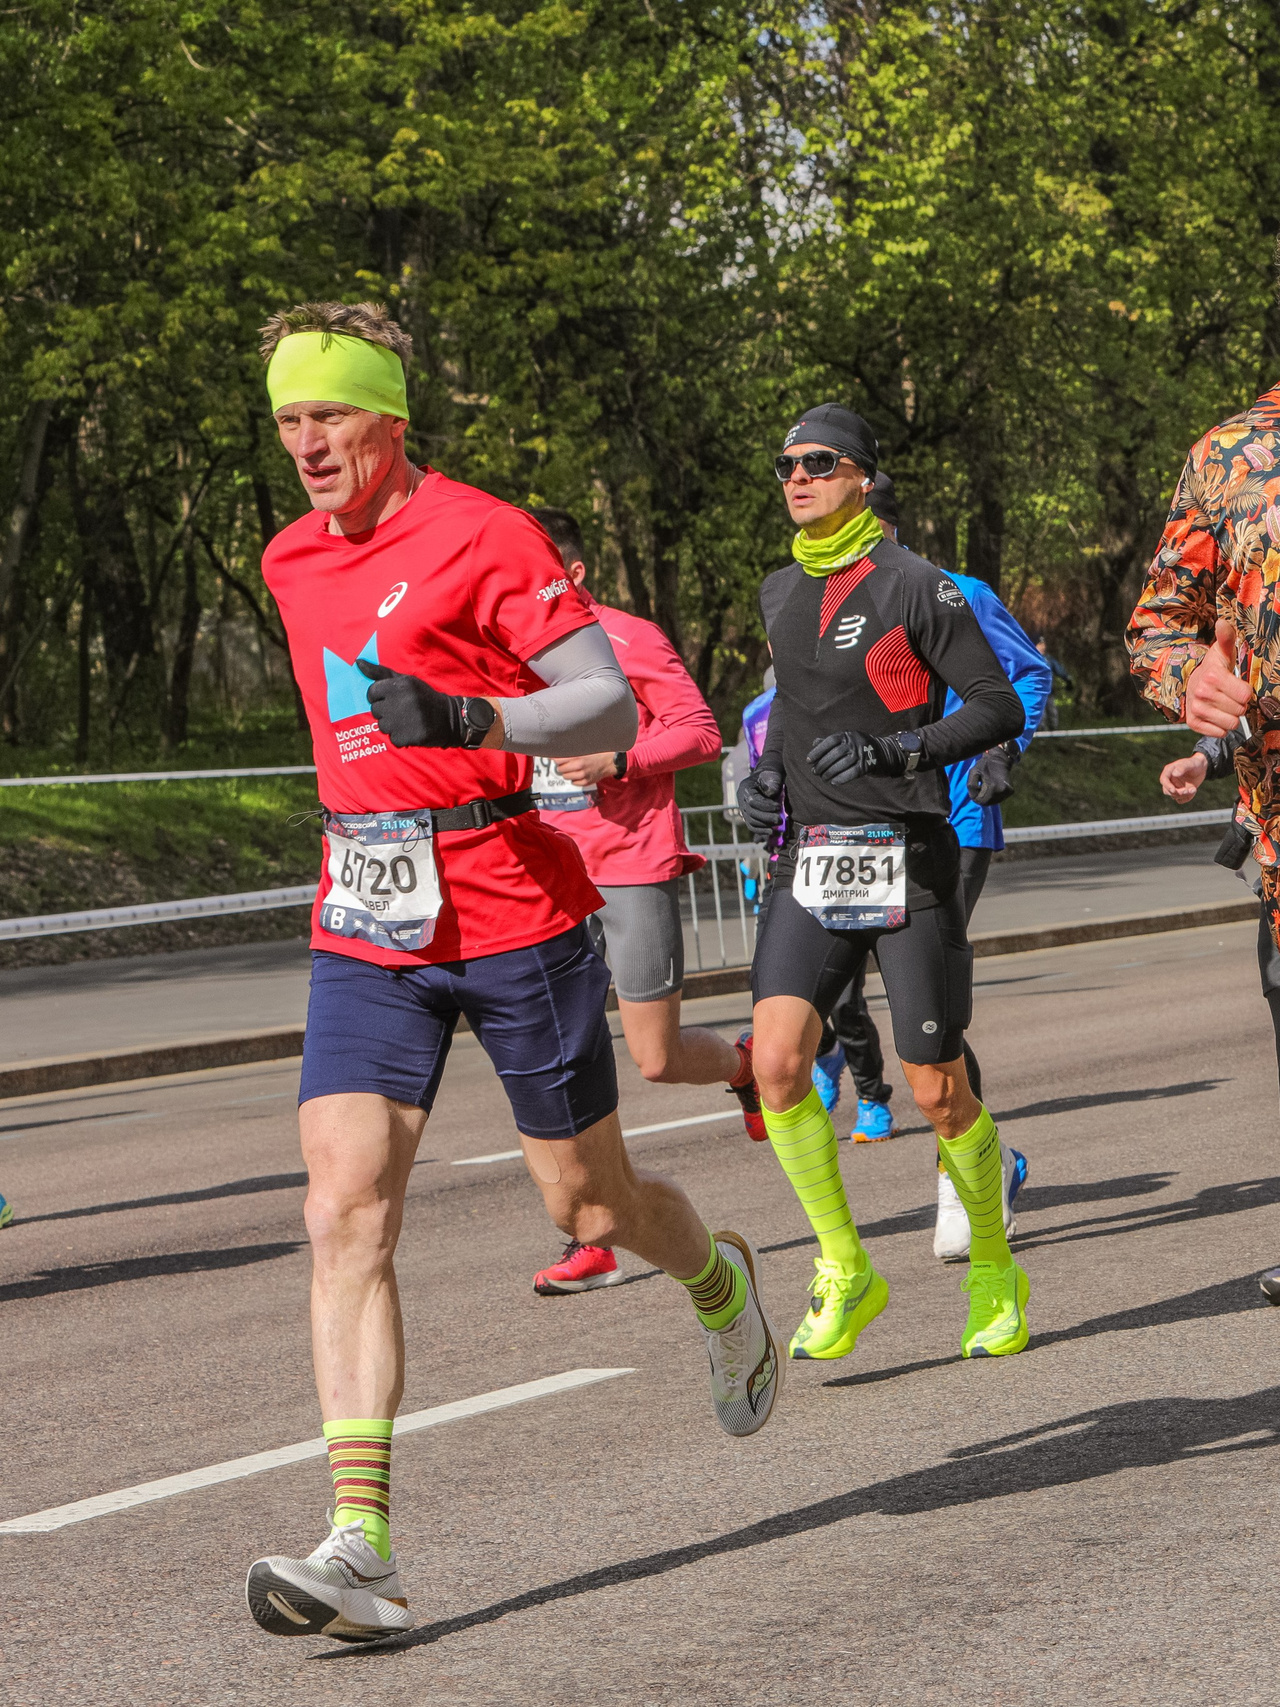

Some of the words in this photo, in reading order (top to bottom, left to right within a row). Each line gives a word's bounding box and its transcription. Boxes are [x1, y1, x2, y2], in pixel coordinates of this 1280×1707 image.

[335, 722, 380, 742] МОСКОВС
[339, 737, 362, 753] ПОЛУ
[341, 742, 387, 764] МАРАФОН
[341, 848, 418, 895] 6720
[800, 855, 895, 887] 17851
[822, 888, 870, 900] ДМИТРИЙ
